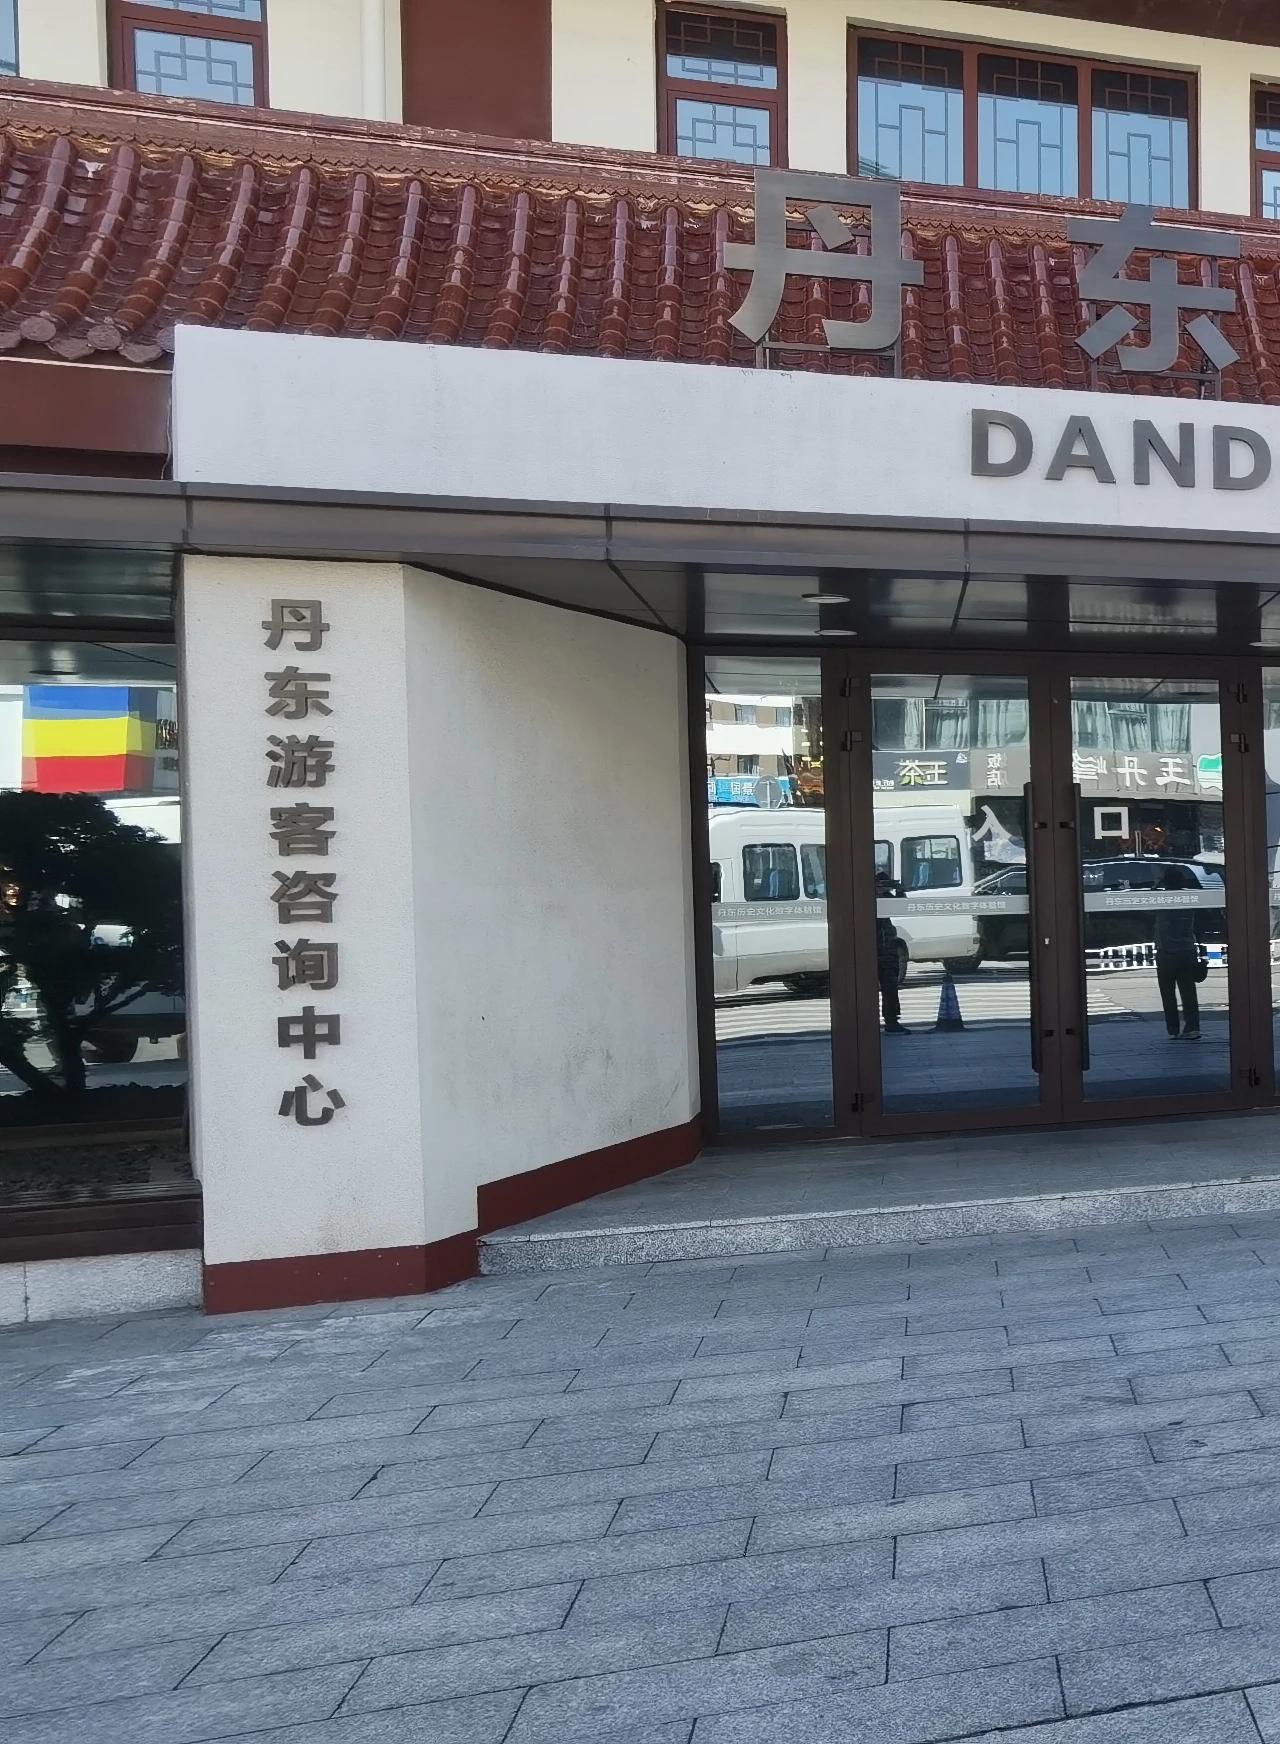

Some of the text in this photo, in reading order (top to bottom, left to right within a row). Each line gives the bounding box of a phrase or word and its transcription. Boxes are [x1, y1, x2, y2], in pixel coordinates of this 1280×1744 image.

[261, 598, 346, 1127] 丹东游客咨询中心
[717, 904, 823, 917] 丹东历史文化数字体验馆
[908, 900, 1007, 912] 丹东历史文化数字体验馆
